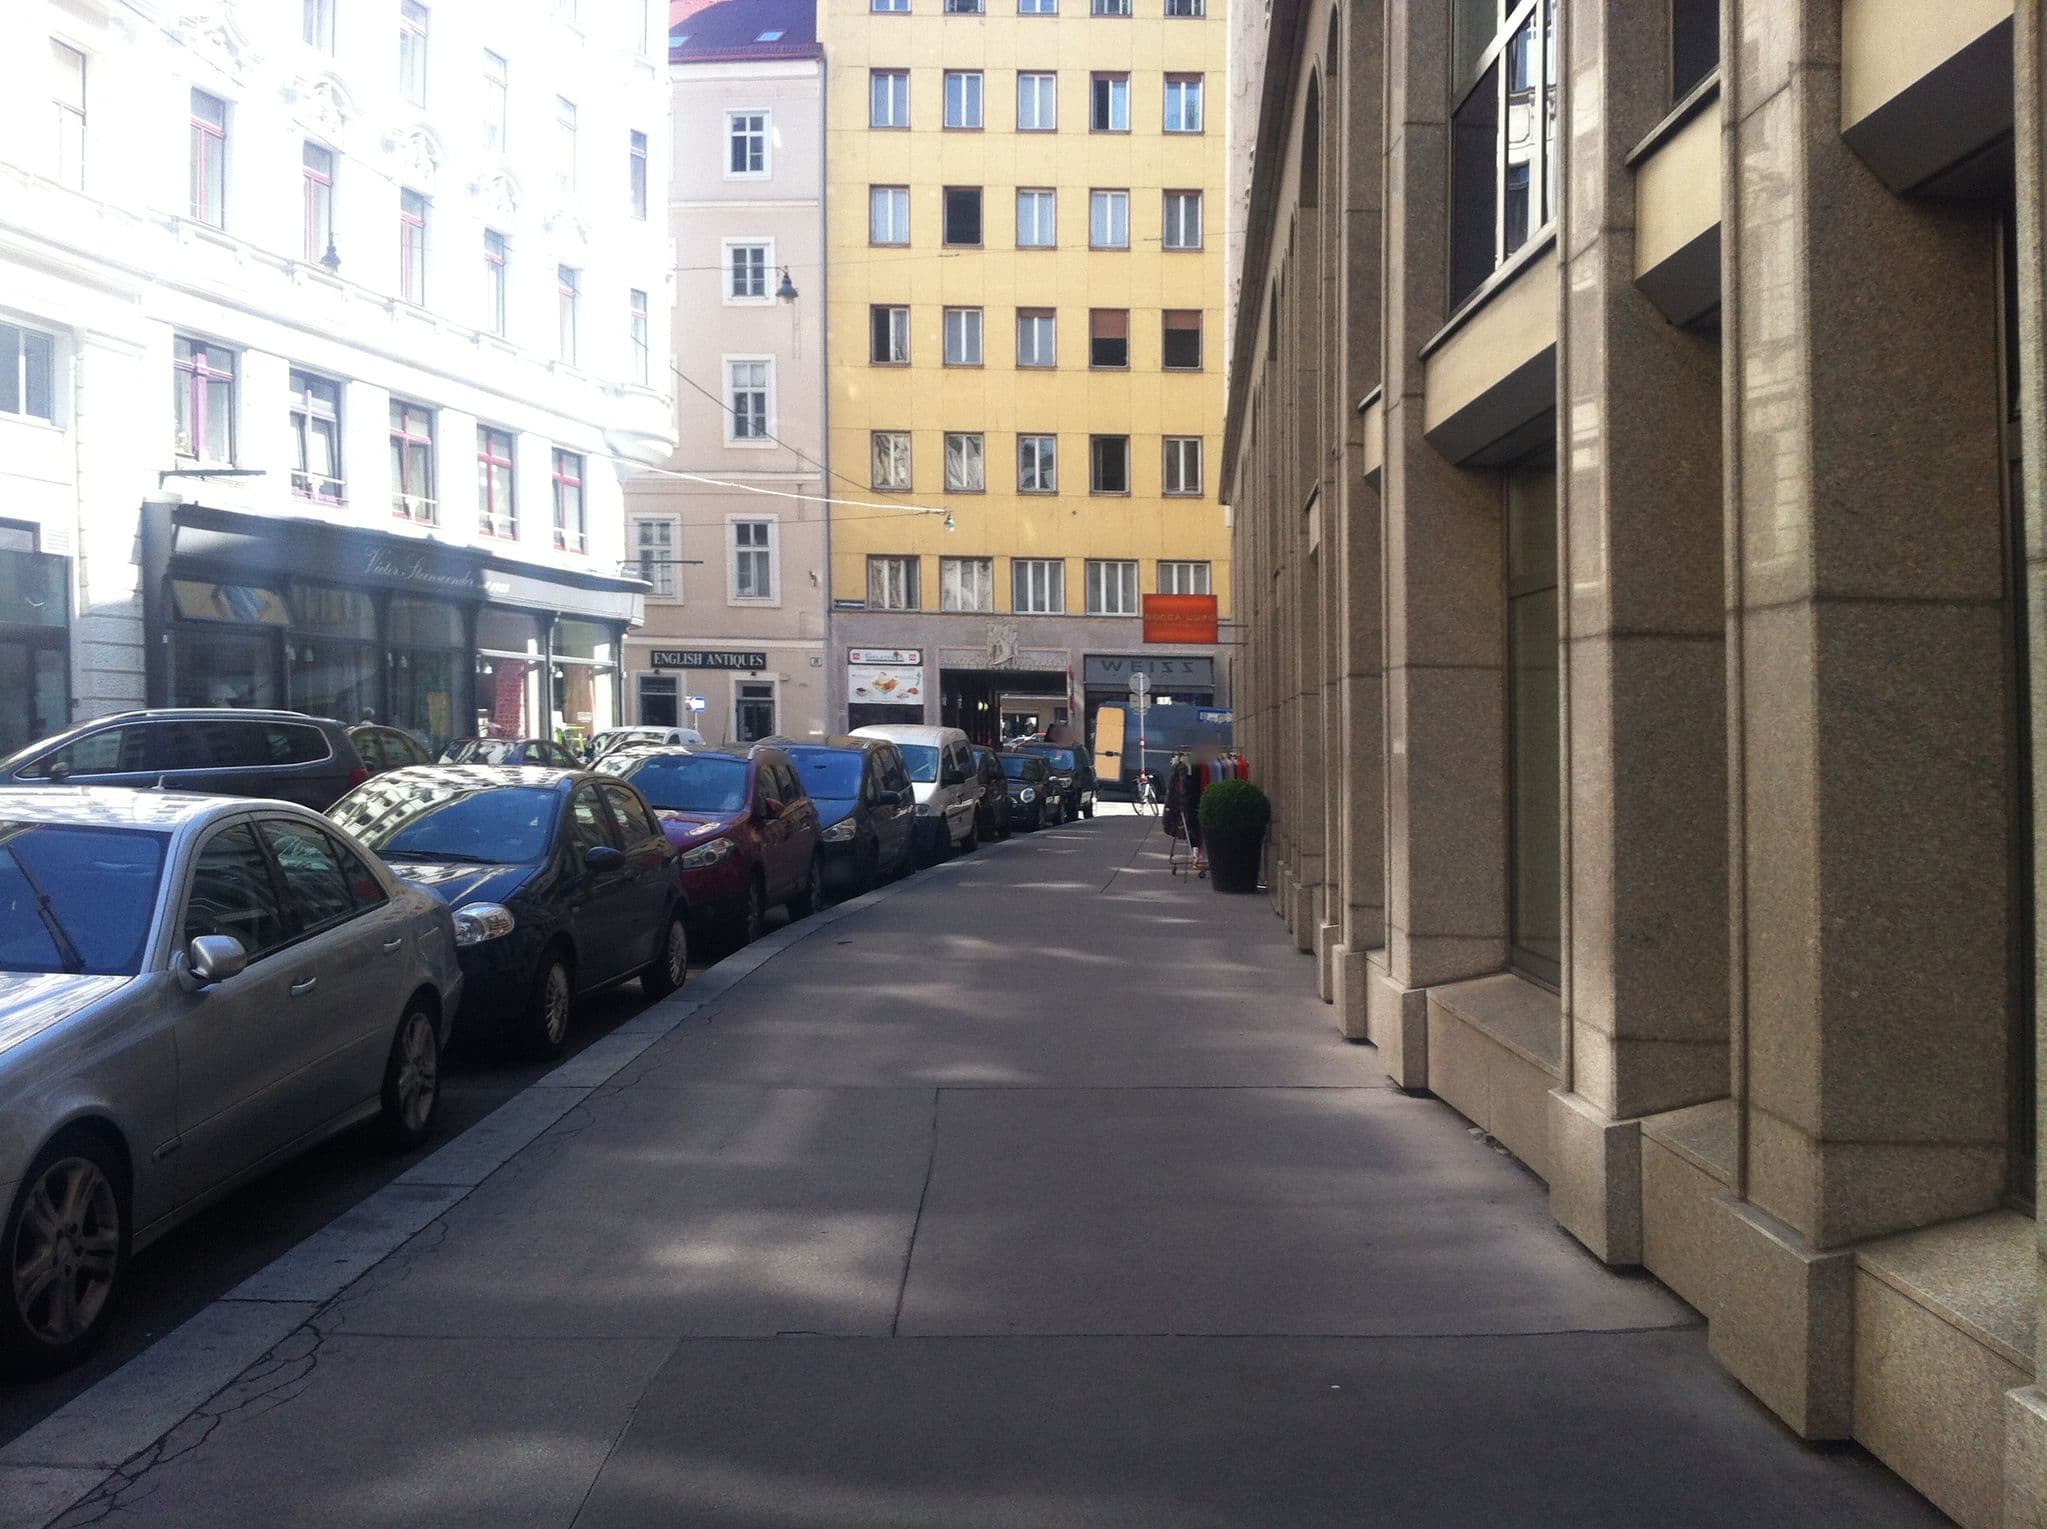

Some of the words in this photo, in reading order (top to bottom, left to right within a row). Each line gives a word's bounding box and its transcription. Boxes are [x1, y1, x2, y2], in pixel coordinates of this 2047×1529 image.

[654, 652, 702, 666] ENGLISH
[706, 654, 764, 668] ANTIQUES
[1101, 660, 1195, 674] WEISS
